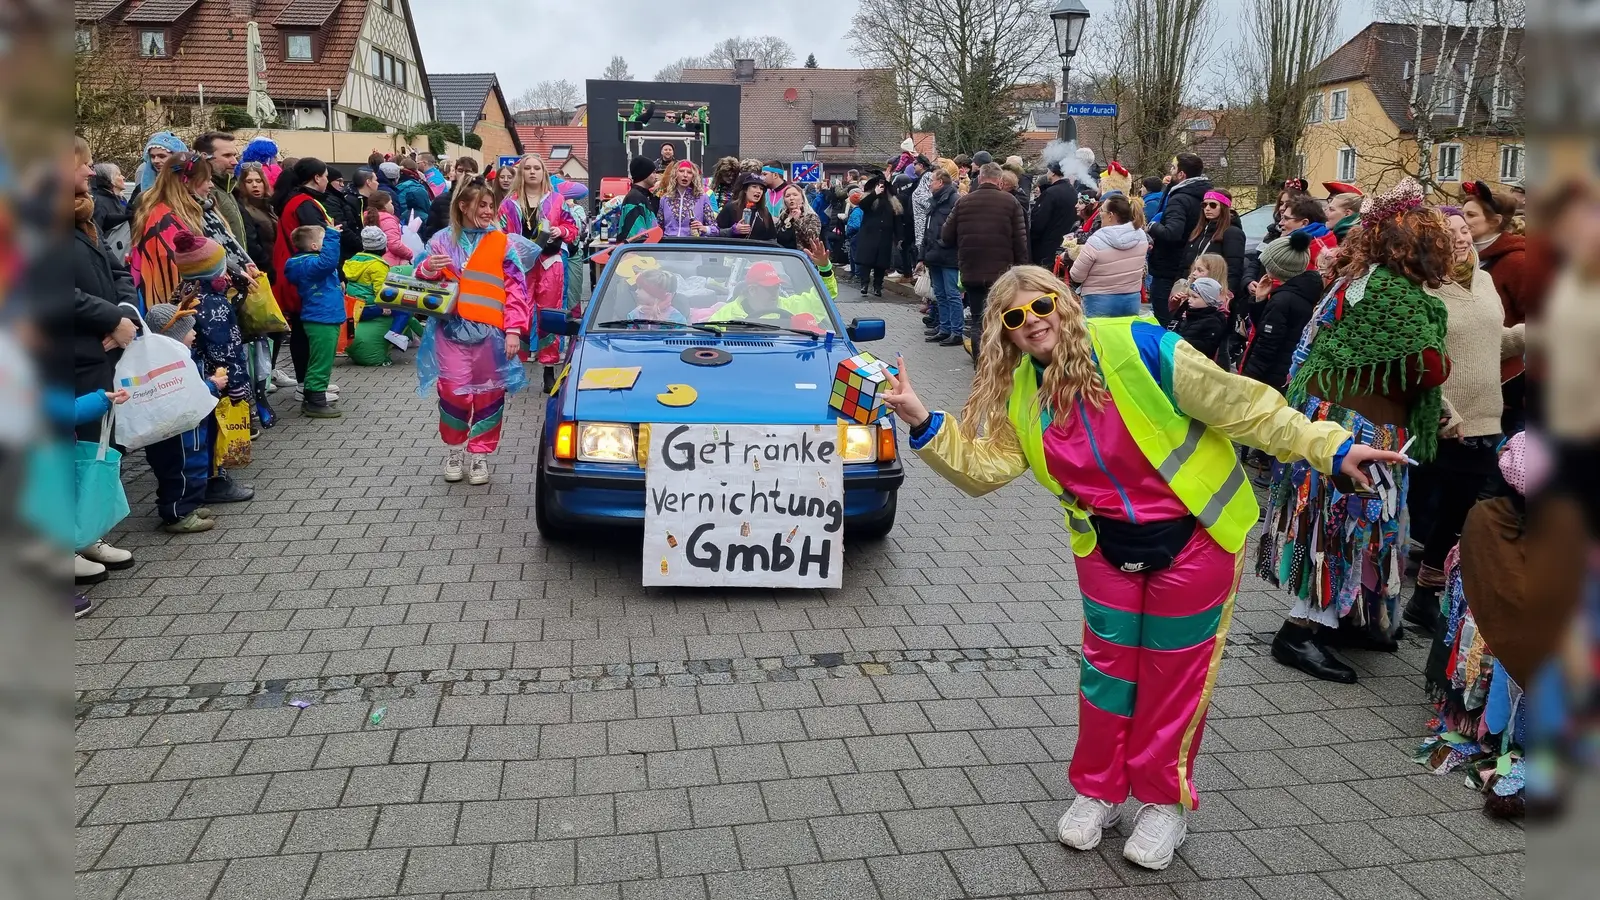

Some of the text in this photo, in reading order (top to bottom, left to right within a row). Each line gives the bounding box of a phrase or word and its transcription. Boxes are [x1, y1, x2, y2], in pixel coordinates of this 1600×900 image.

[1092, 106, 1114, 114] Aurach
[157, 377, 183, 390] family
[661, 425, 835, 471] Getränke
[652, 478, 842, 532] Vernichtung
[686, 523, 831, 578] GmbH
[1124, 562, 1144, 570] NIKE
